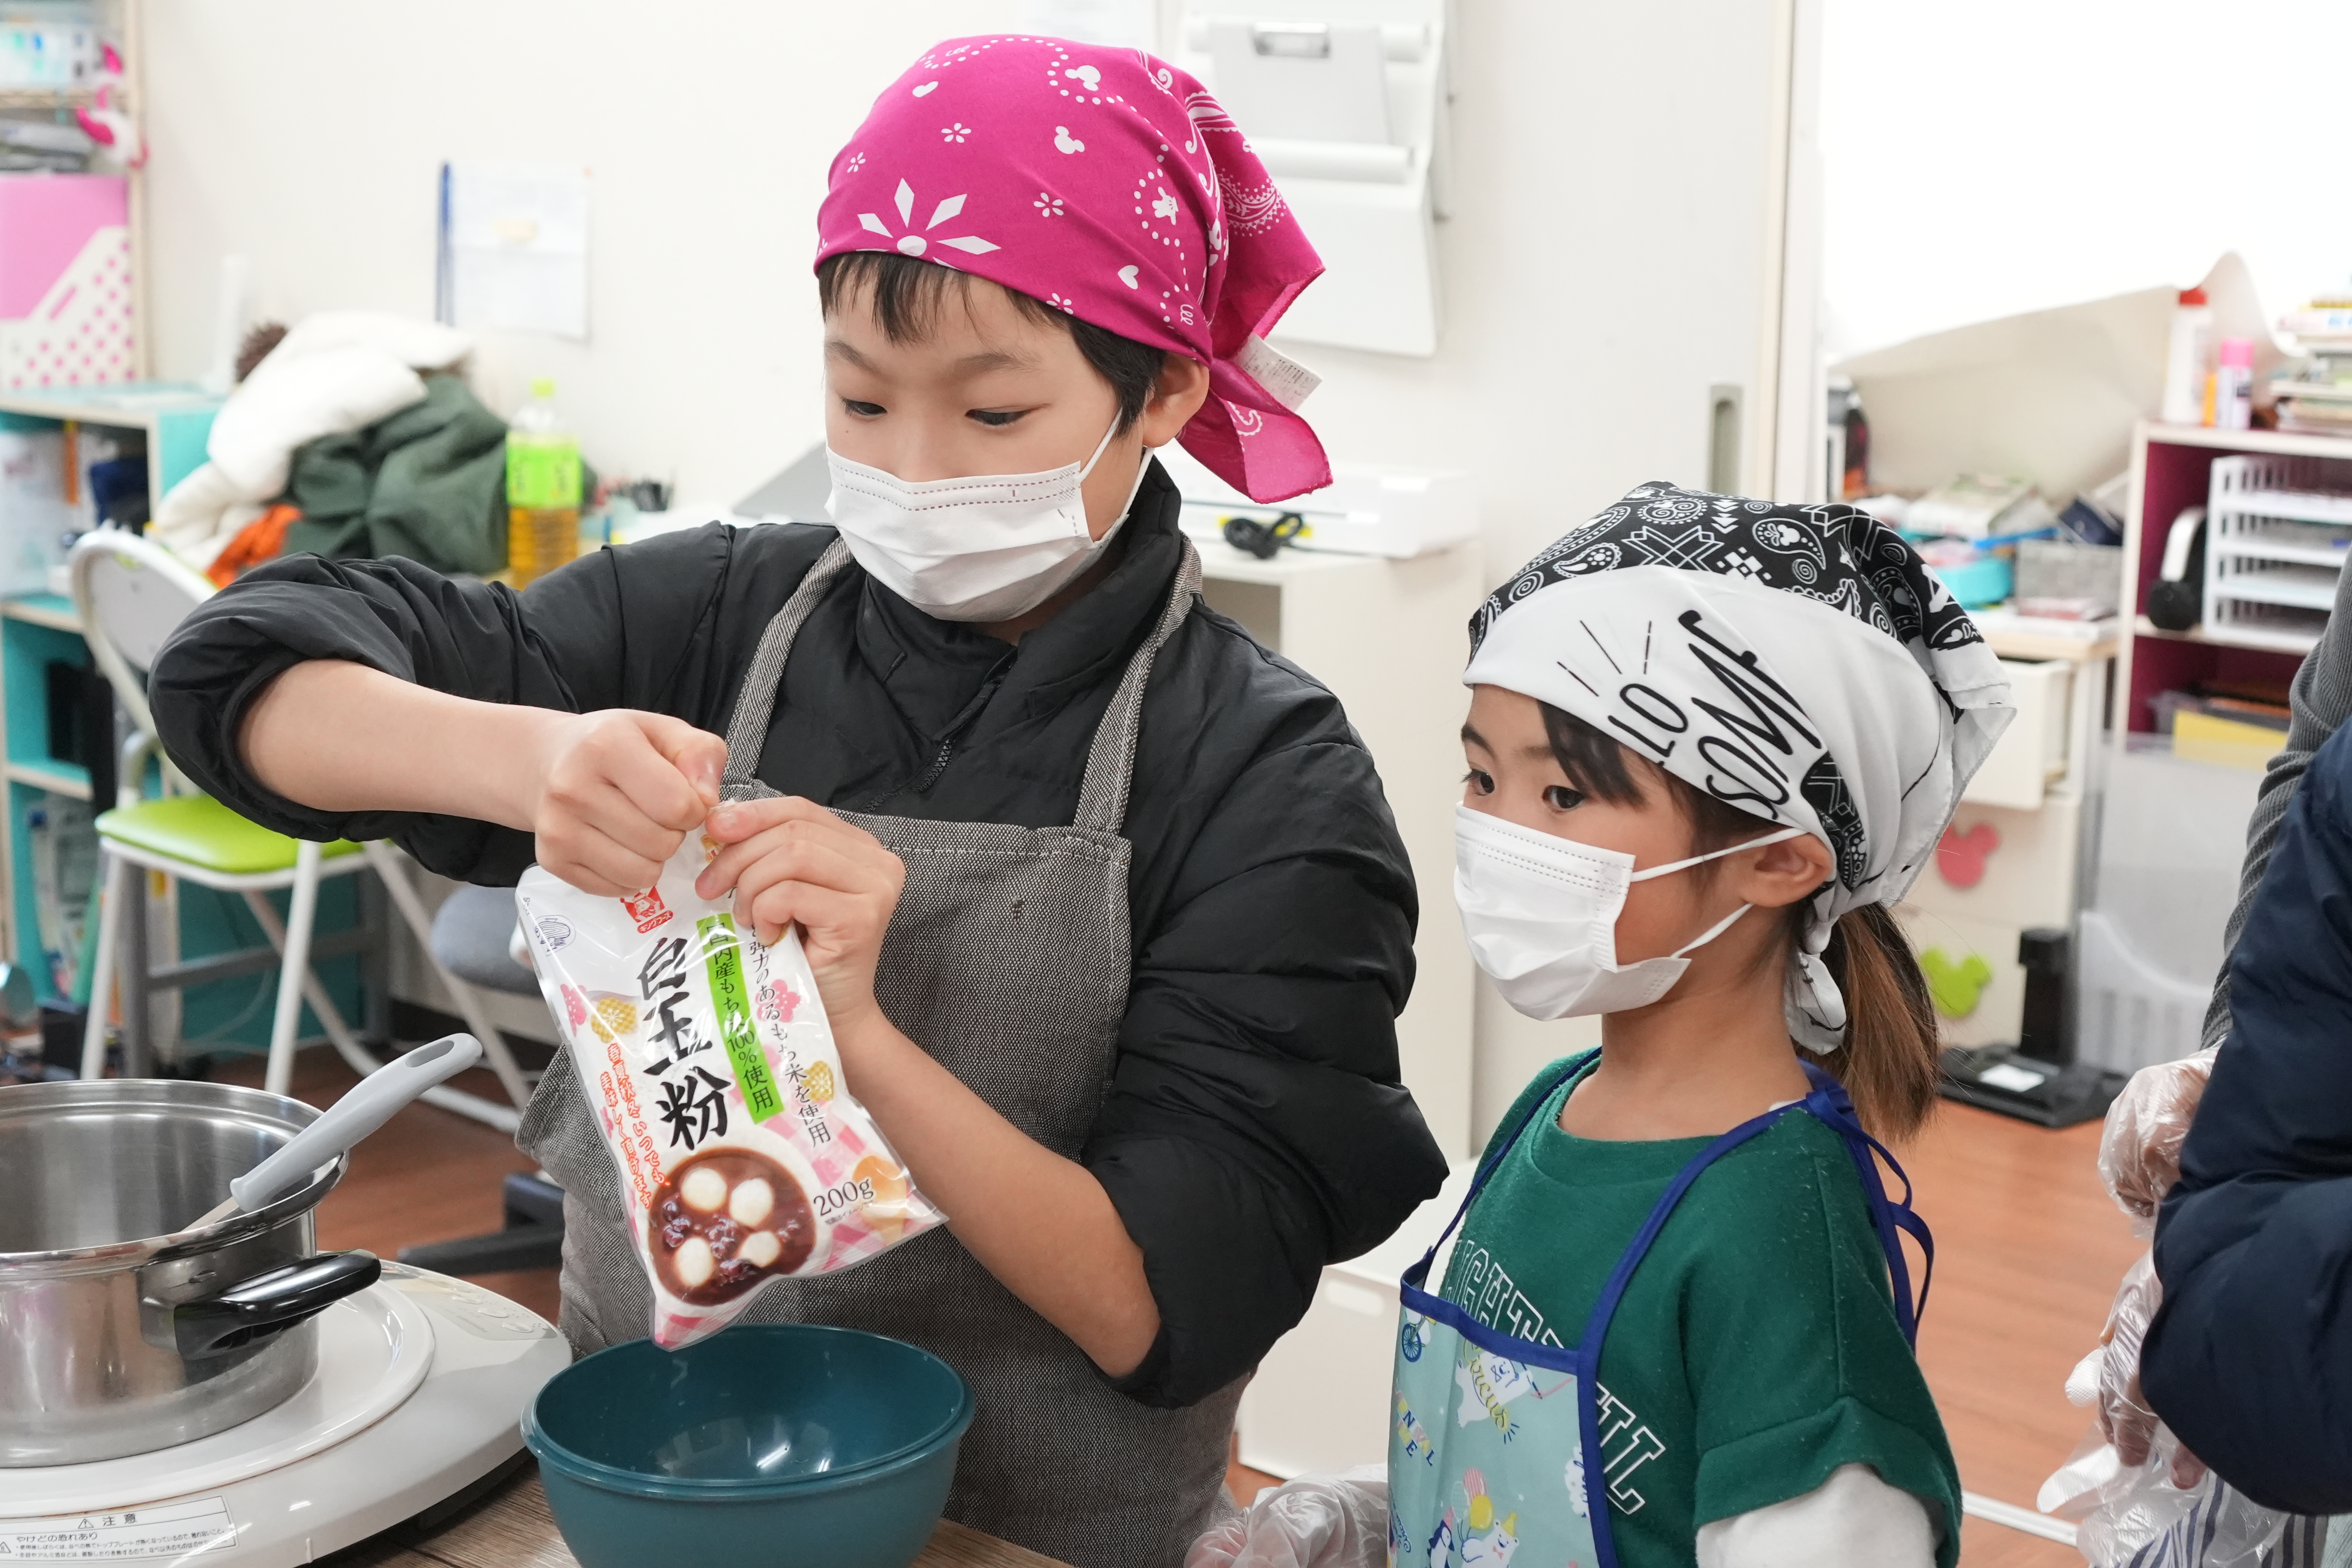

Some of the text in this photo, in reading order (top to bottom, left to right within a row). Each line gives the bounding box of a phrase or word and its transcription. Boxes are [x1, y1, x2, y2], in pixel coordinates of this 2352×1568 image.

[639, 911, 672, 933] キングフーズ
[636, 937, 731, 1150] 白玉粉
[814, 1179, 873, 1217] 200g
[103, 1513, 137, 1527] 注意
[16, 1532, 97, 1543] やけどの恐れあり
